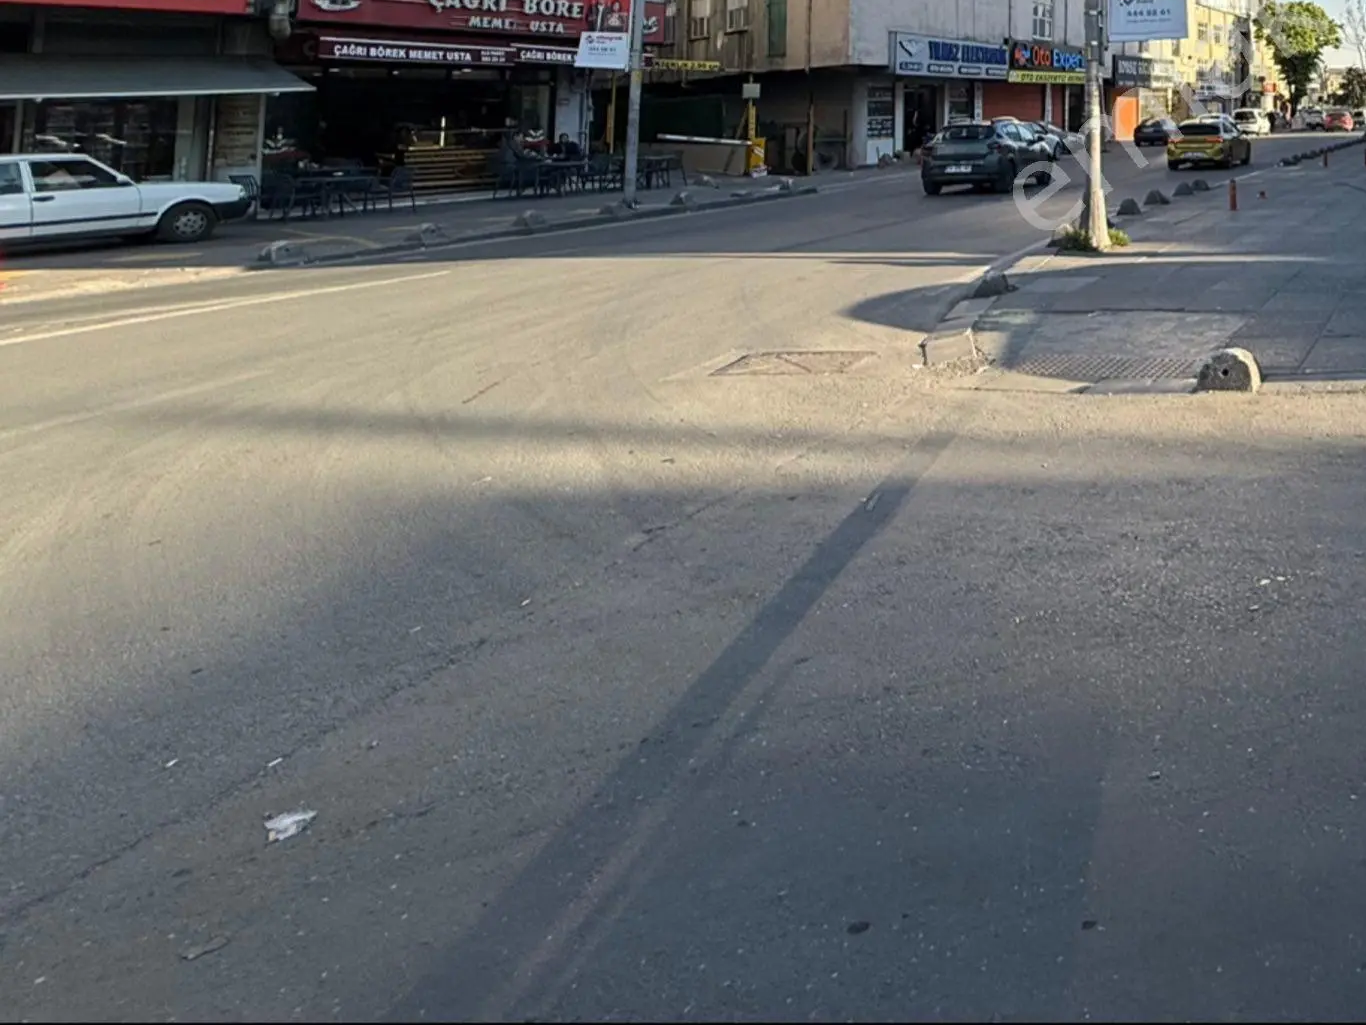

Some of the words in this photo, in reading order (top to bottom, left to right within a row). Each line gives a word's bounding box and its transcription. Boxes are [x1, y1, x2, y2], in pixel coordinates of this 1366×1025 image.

[529, 20, 565, 34] USTA
[334, 43, 367, 58] ÇAĞRI
[369, 45, 407, 58] BÖREK
[408, 49, 444, 61] MEMET
[446, 51, 472, 62] USTA
[520, 49, 545, 61] ÇAĞRI
[1032, 45, 1052, 65] Oto
